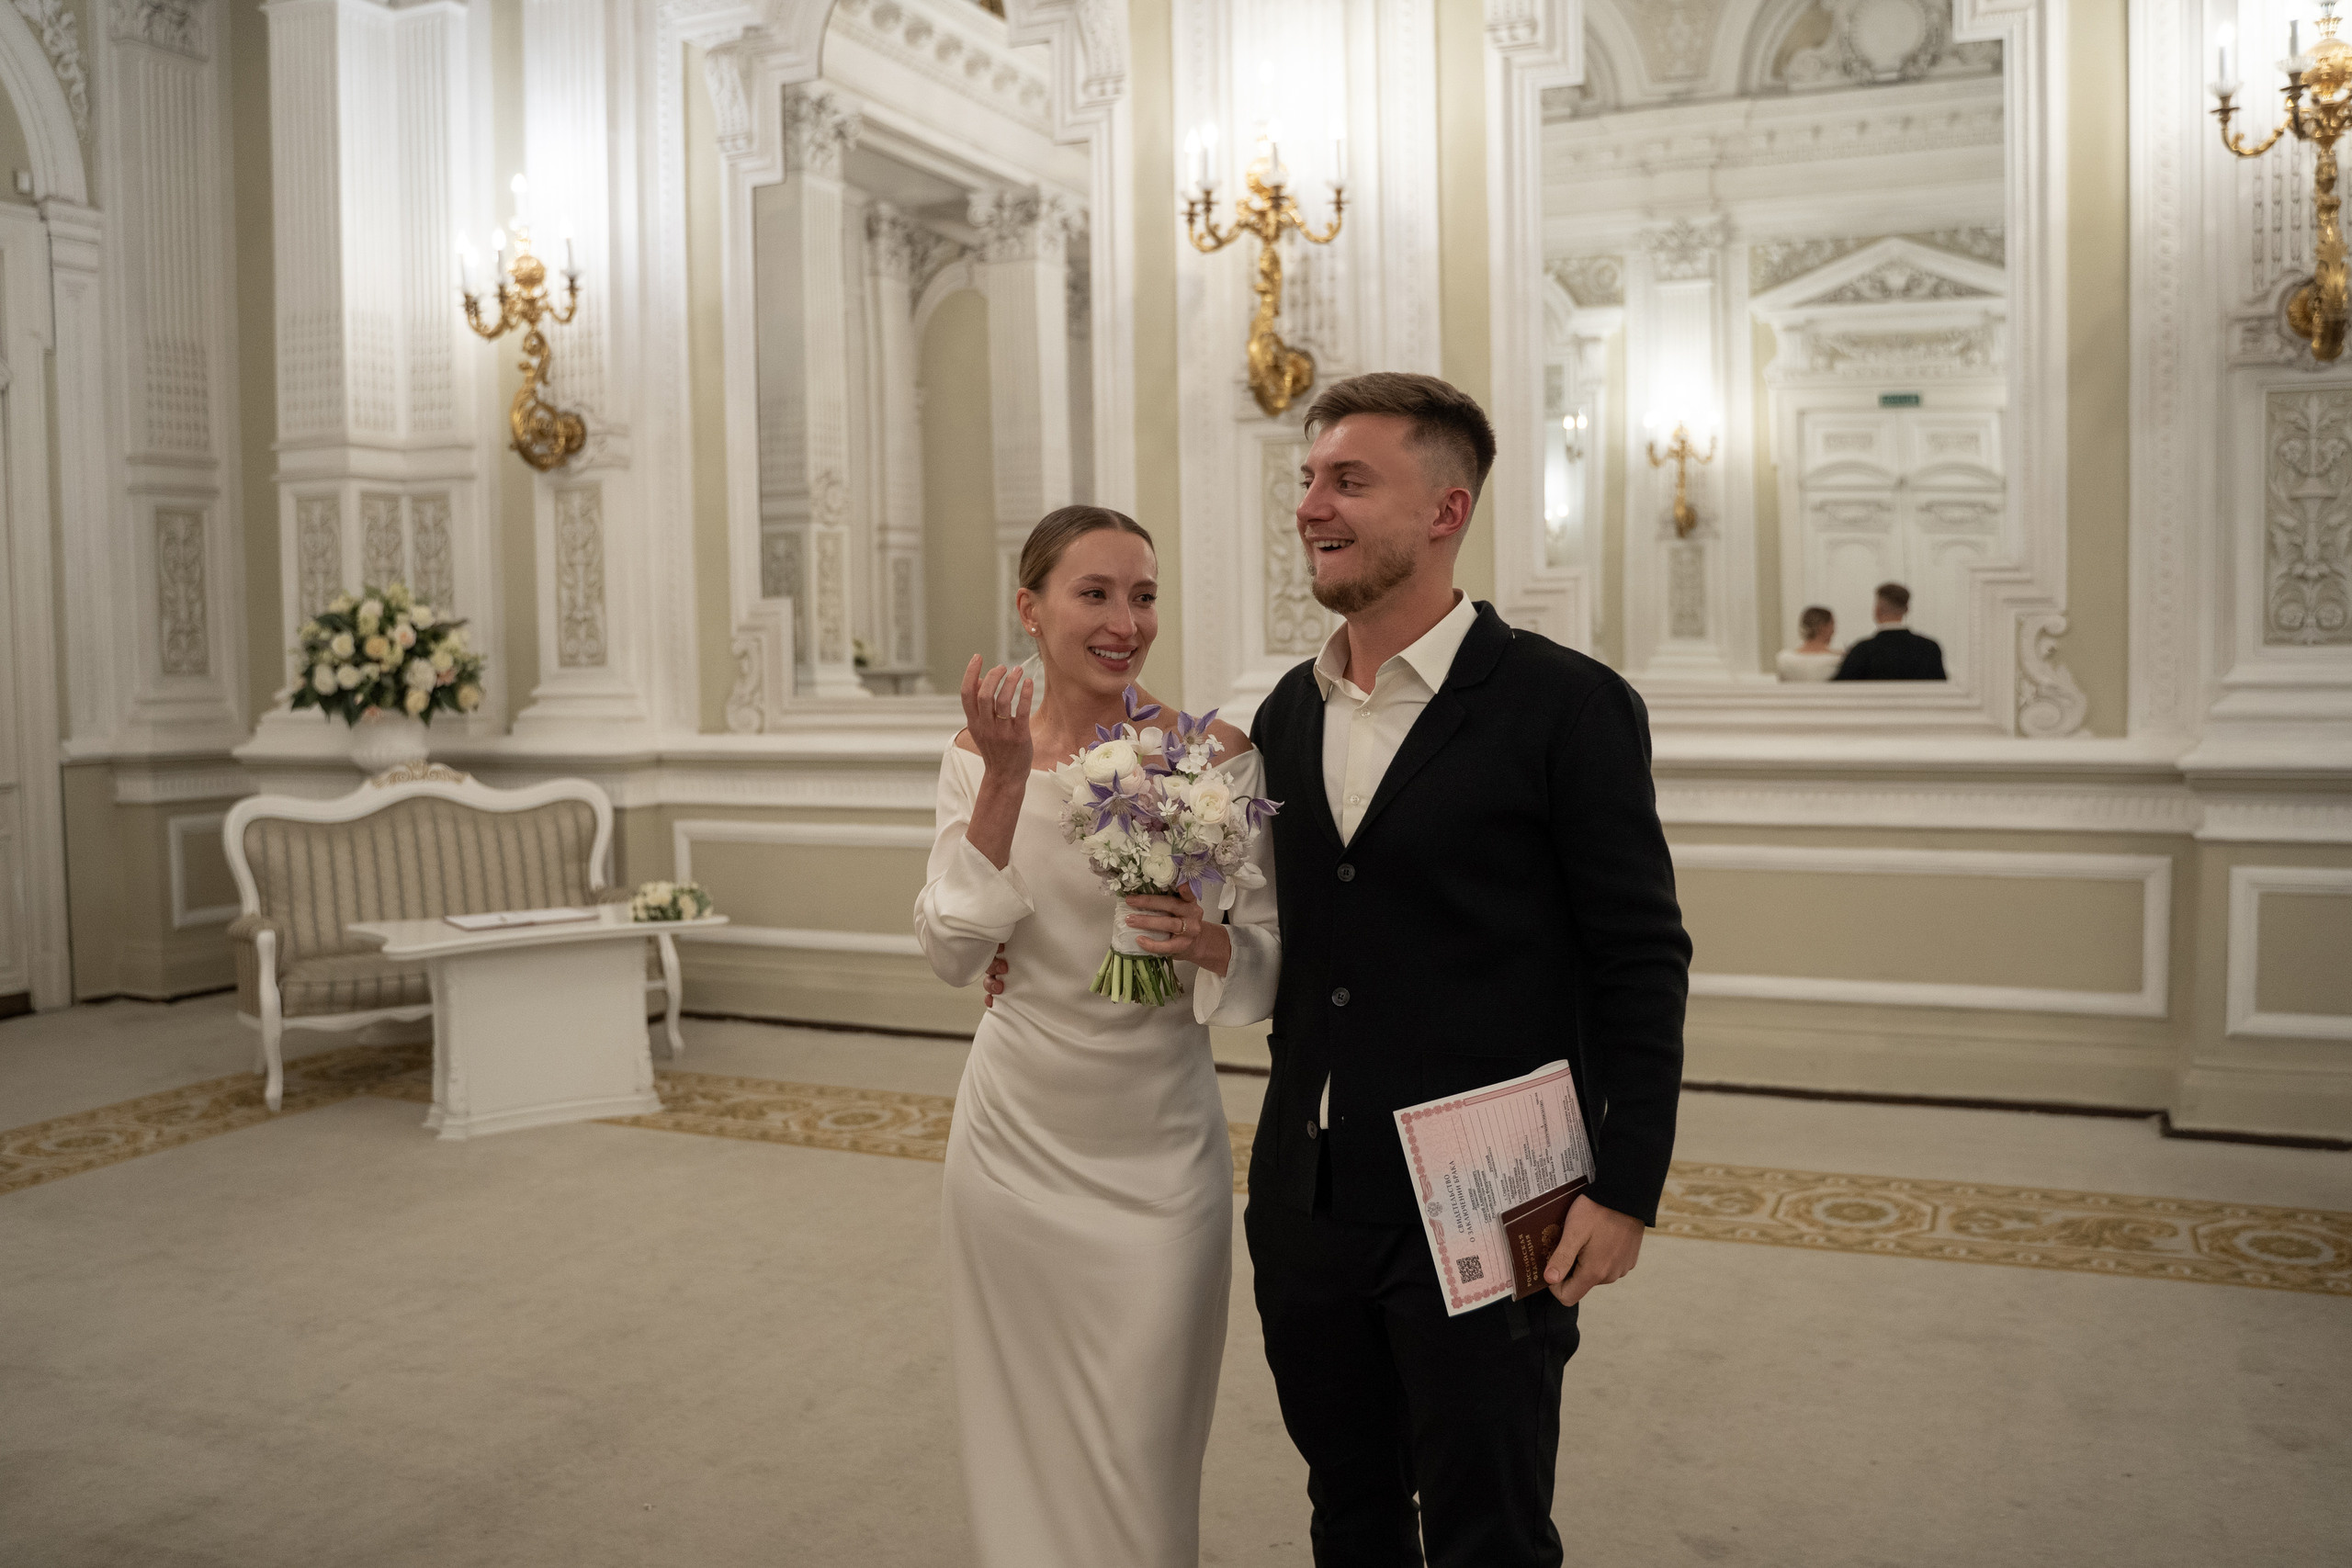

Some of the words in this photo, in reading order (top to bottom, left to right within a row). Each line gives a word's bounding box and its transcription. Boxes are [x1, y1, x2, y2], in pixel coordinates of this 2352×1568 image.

[1449, 1161, 1460, 1183] БРАКА
[1443, 1174, 1464, 1234] СВИДЕТЕЛЬСТВО
[1456, 1185, 1474, 1235] ЗАКЛЮЧЕНИИ
[1519, 1234, 1532, 1287] РОССИЙСКАЯ
[1525, 1235, 1539, 1280] ФЕДЕРАЦИЯ
